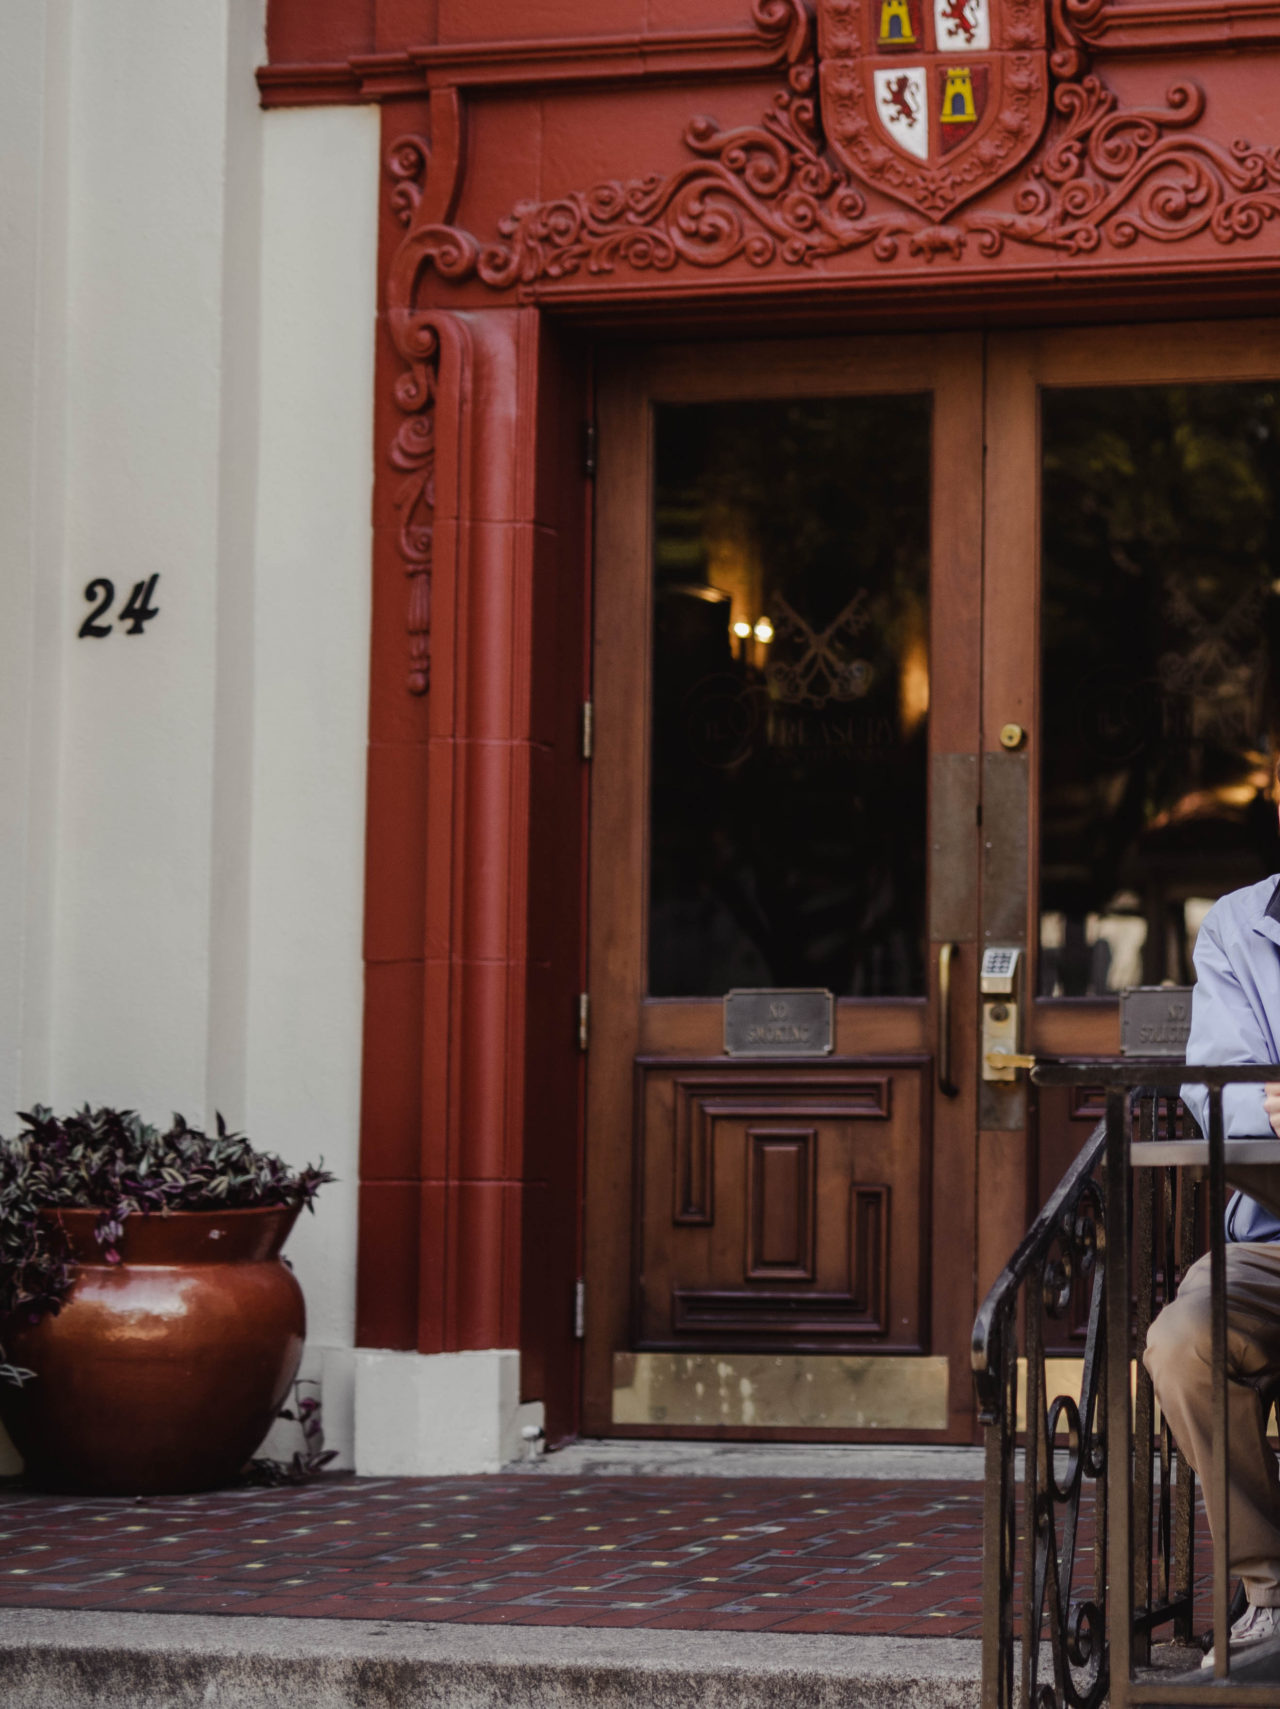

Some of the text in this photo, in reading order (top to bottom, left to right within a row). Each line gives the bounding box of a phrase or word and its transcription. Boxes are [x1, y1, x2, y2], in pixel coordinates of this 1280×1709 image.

[77, 572, 160, 638] 24
[768, 1001, 788, 1021] NO
[1168, 1003, 1186, 1022] NO
[747, 1024, 810, 1043] SMOKING
